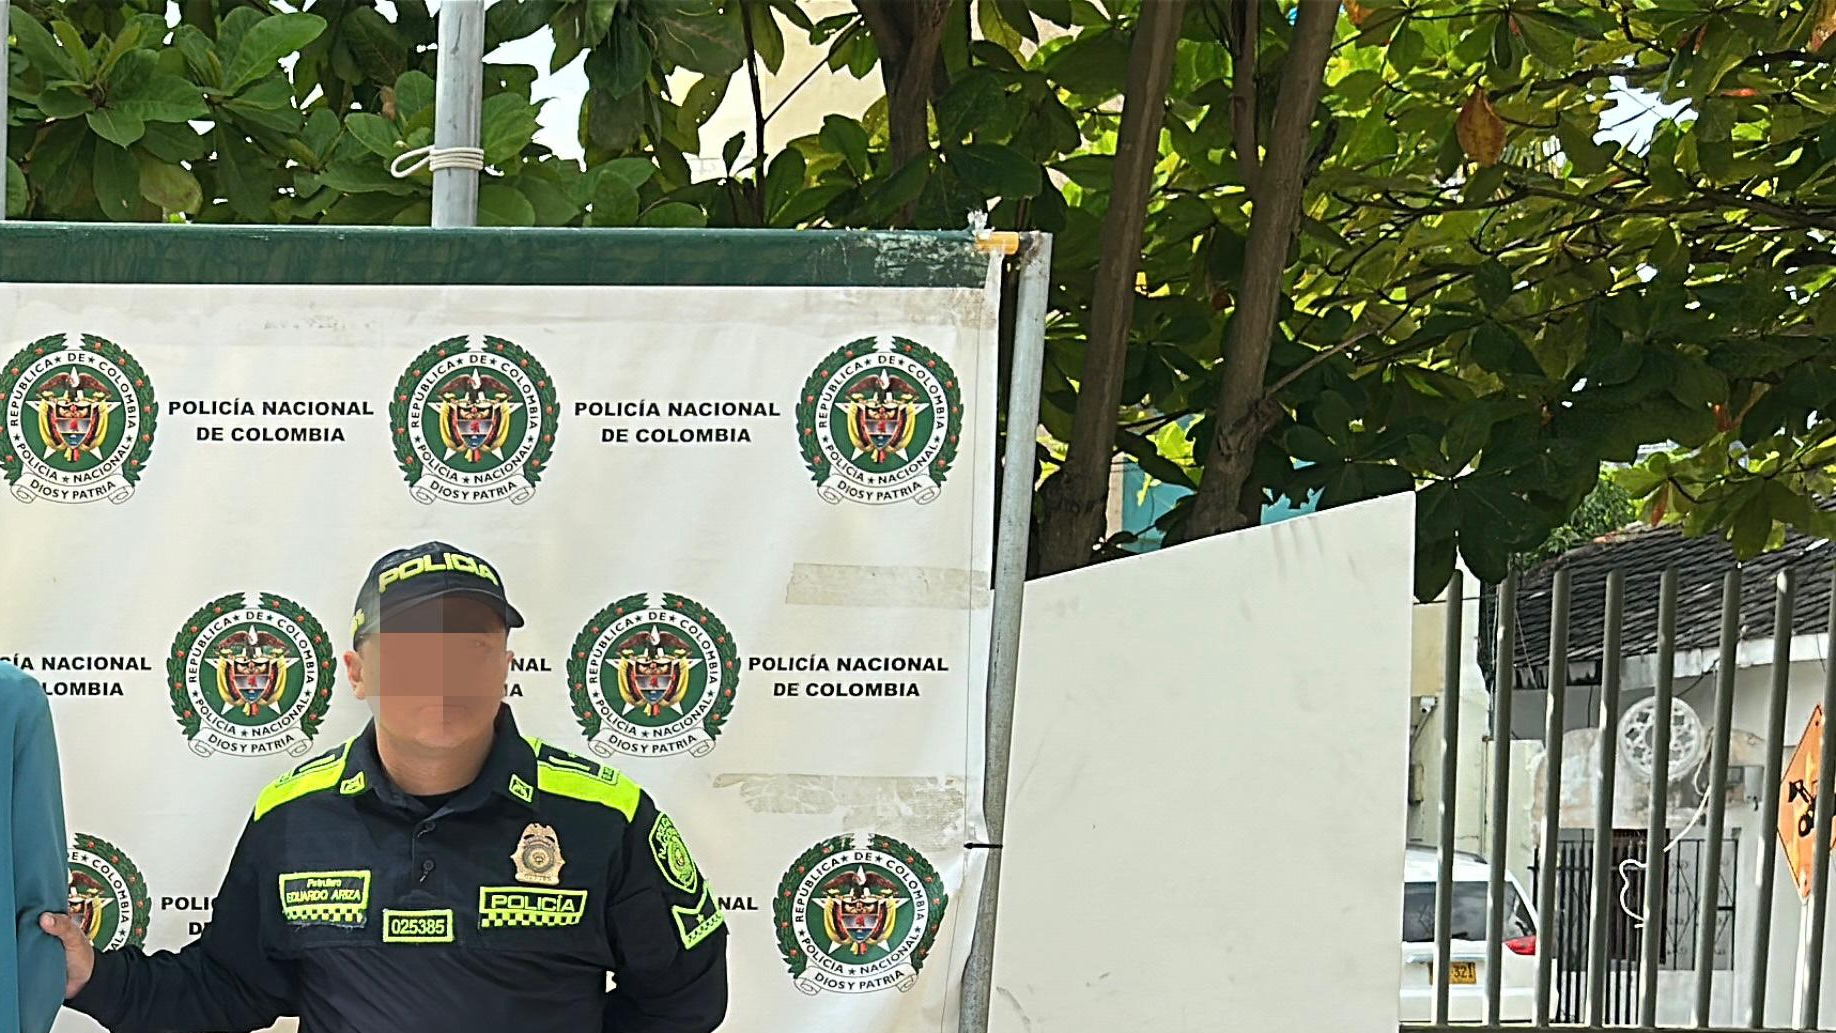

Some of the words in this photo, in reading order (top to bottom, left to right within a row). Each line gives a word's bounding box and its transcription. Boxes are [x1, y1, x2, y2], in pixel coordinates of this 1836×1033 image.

[67, 351, 86, 363] DE
[97, 360, 140, 429] COLOMBIA
[877, 354, 896, 365] DE
[907, 362, 948, 430] COLOMBIA
[168, 397, 255, 416] POLICÍA
[262, 401, 374, 416] NACIONAL
[574, 399, 661, 417] POLICÍA
[667, 402, 781, 417] NACIONAL
[196, 426, 224, 442] DE
[230, 427, 346, 442] COLOMBIA
[601, 428, 629, 443] DE
[635, 428, 752, 443] COLOMBIA
[73, 444, 133, 483] NACIONAL
[879, 444, 940, 484] NACIONAL
[29, 477, 62, 498] DIOS
[72, 479, 119, 502] PATRIA
[835, 479, 868, 499] DIOS
[878, 480, 925, 503] PATRIA
[648, 611, 668, 622] DE
[679, 619, 722, 685] COLOMBIA
[41, 656, 152, 671] NACIONAL
[748, 654, 830, 672] POLICÍA
[836, 657, 949, 672] NACIONAL
[47, 681, 124, 696] LOMBIA
[773, 682, 800, 697] DE
[805, 682, 920, 697] COLOMBIA
[653, 698, 715, 737] NACIONAL
[608, 732, 642, 752] DIOS
[652, 733, 700, 755] PATRIA
[286, 890, 328, 903] EDUARDO
[854, 851, 874, 862] DE
[885, 858, 928, 922] COLOMBIA
[161, 896, 220, 913] POLI
[491, 894, 576, 911] POLICÍA
[391, 920, 445, 935] 025385
[859, 936, 921, 974] NACIONAL
[814, 970, 848, 989] DIOS
[858, 970, 906, 991] PATRIA
